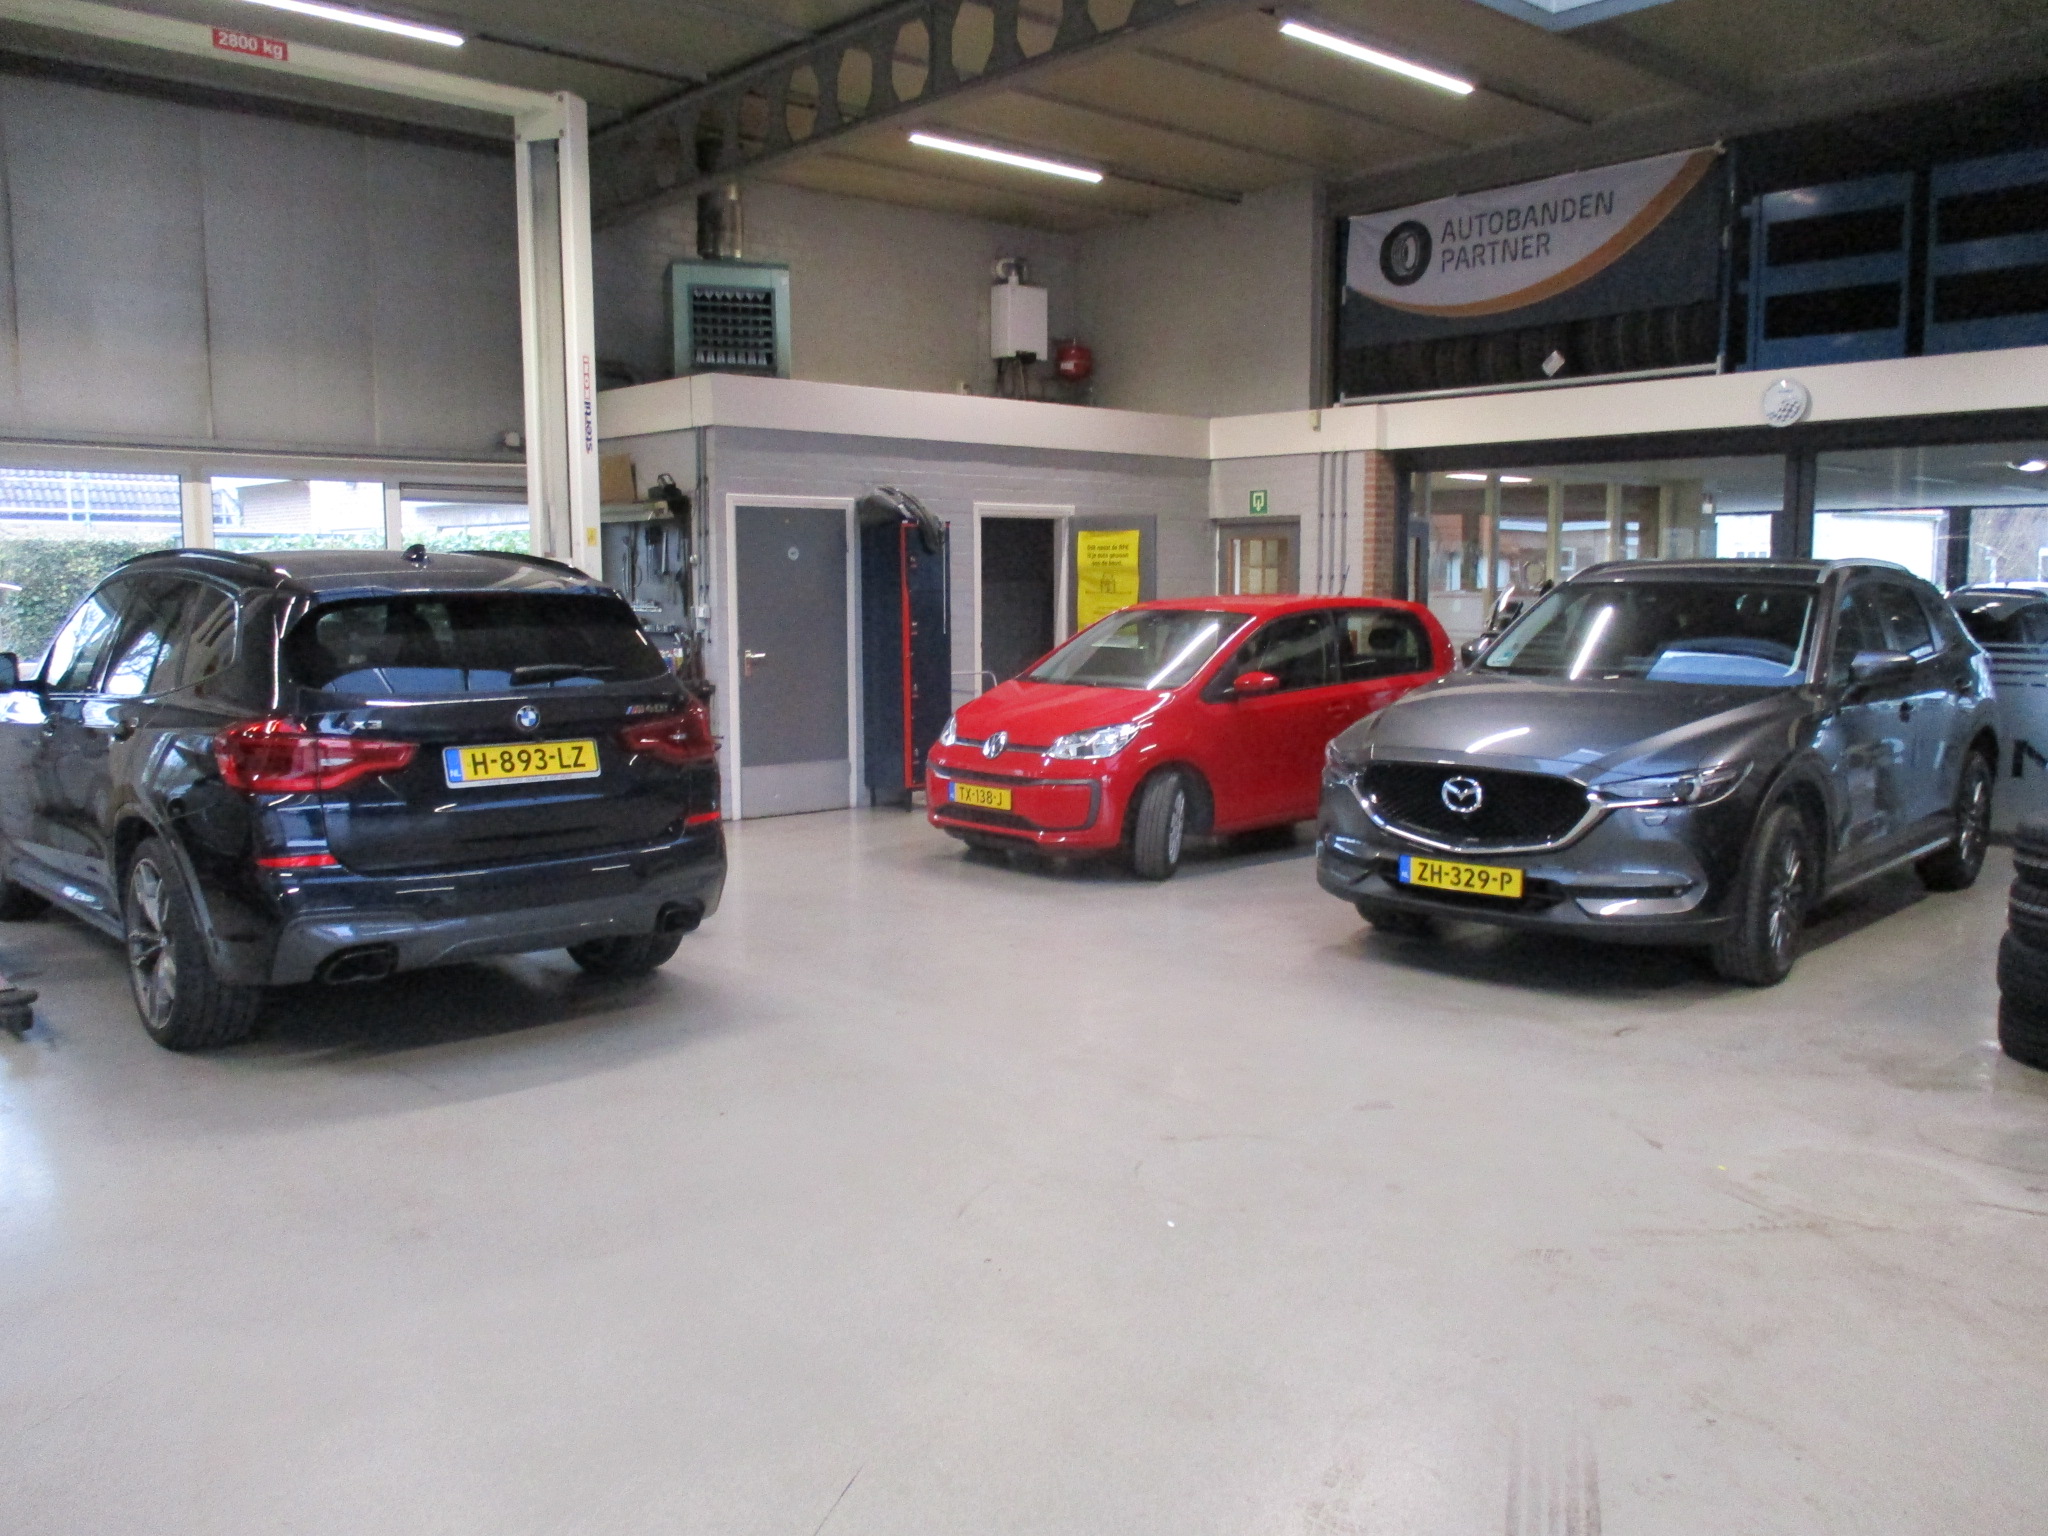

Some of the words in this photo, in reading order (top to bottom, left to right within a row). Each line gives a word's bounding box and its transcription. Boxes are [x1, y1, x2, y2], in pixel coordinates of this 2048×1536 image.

[217, 31, 259, 52] 2800
[262, 39, 284, 60] kg
[1440, 190, 1616, 245] AUTOBANDEN
[1440, 233, 1552, 274] PARTNER
[470, 745, 587, 776] H-893-LZ
[959, 786, 1003, 807] TX-138-J
[1417, 862, 1514, 892] ZH-329-P
